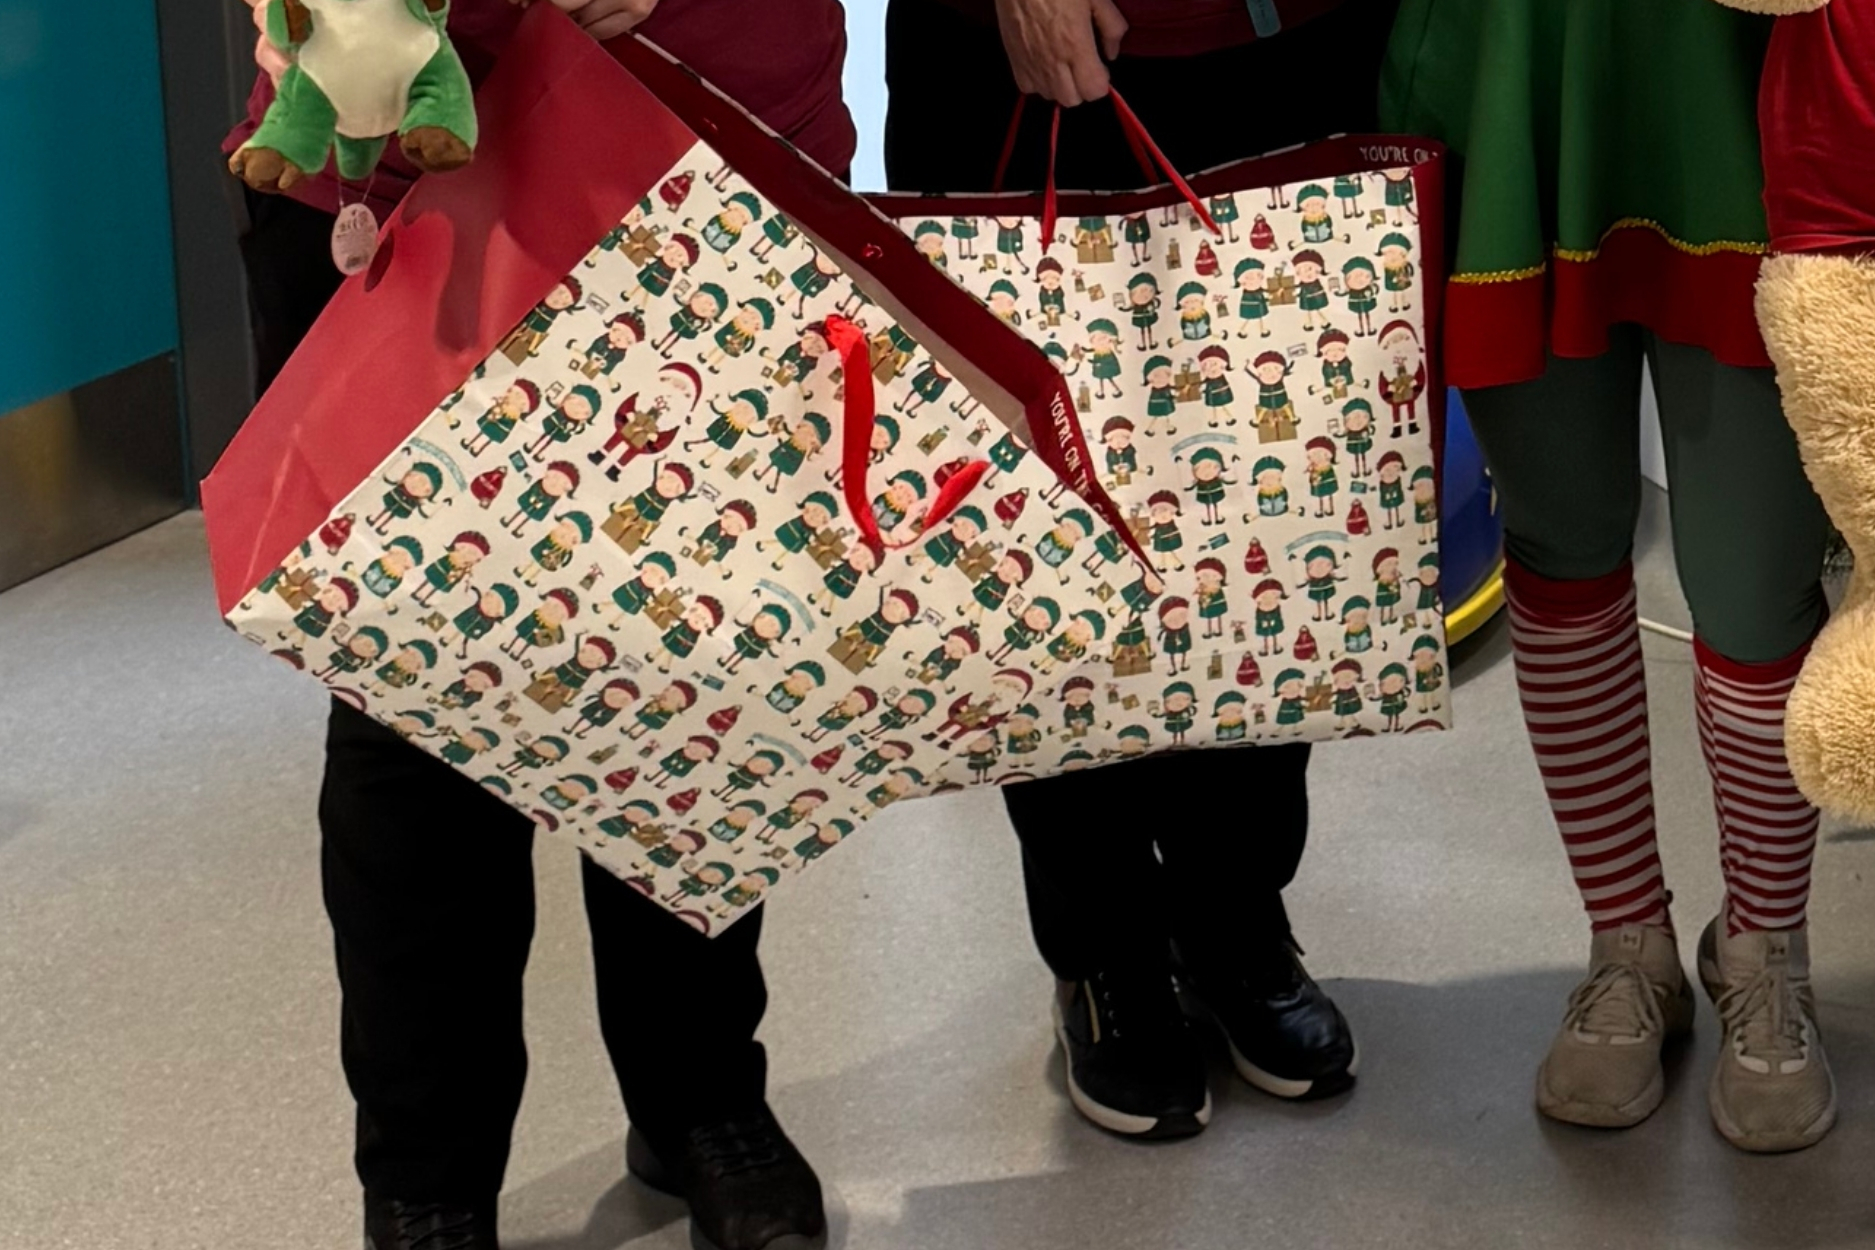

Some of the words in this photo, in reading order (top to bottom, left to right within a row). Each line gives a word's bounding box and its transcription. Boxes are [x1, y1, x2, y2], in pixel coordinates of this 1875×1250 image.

[1359, 145, 1411, 163] YOU'RE
[1050, 391, 1074, 449] YOU'RE
[1064, 446, 1082, 473] ON
